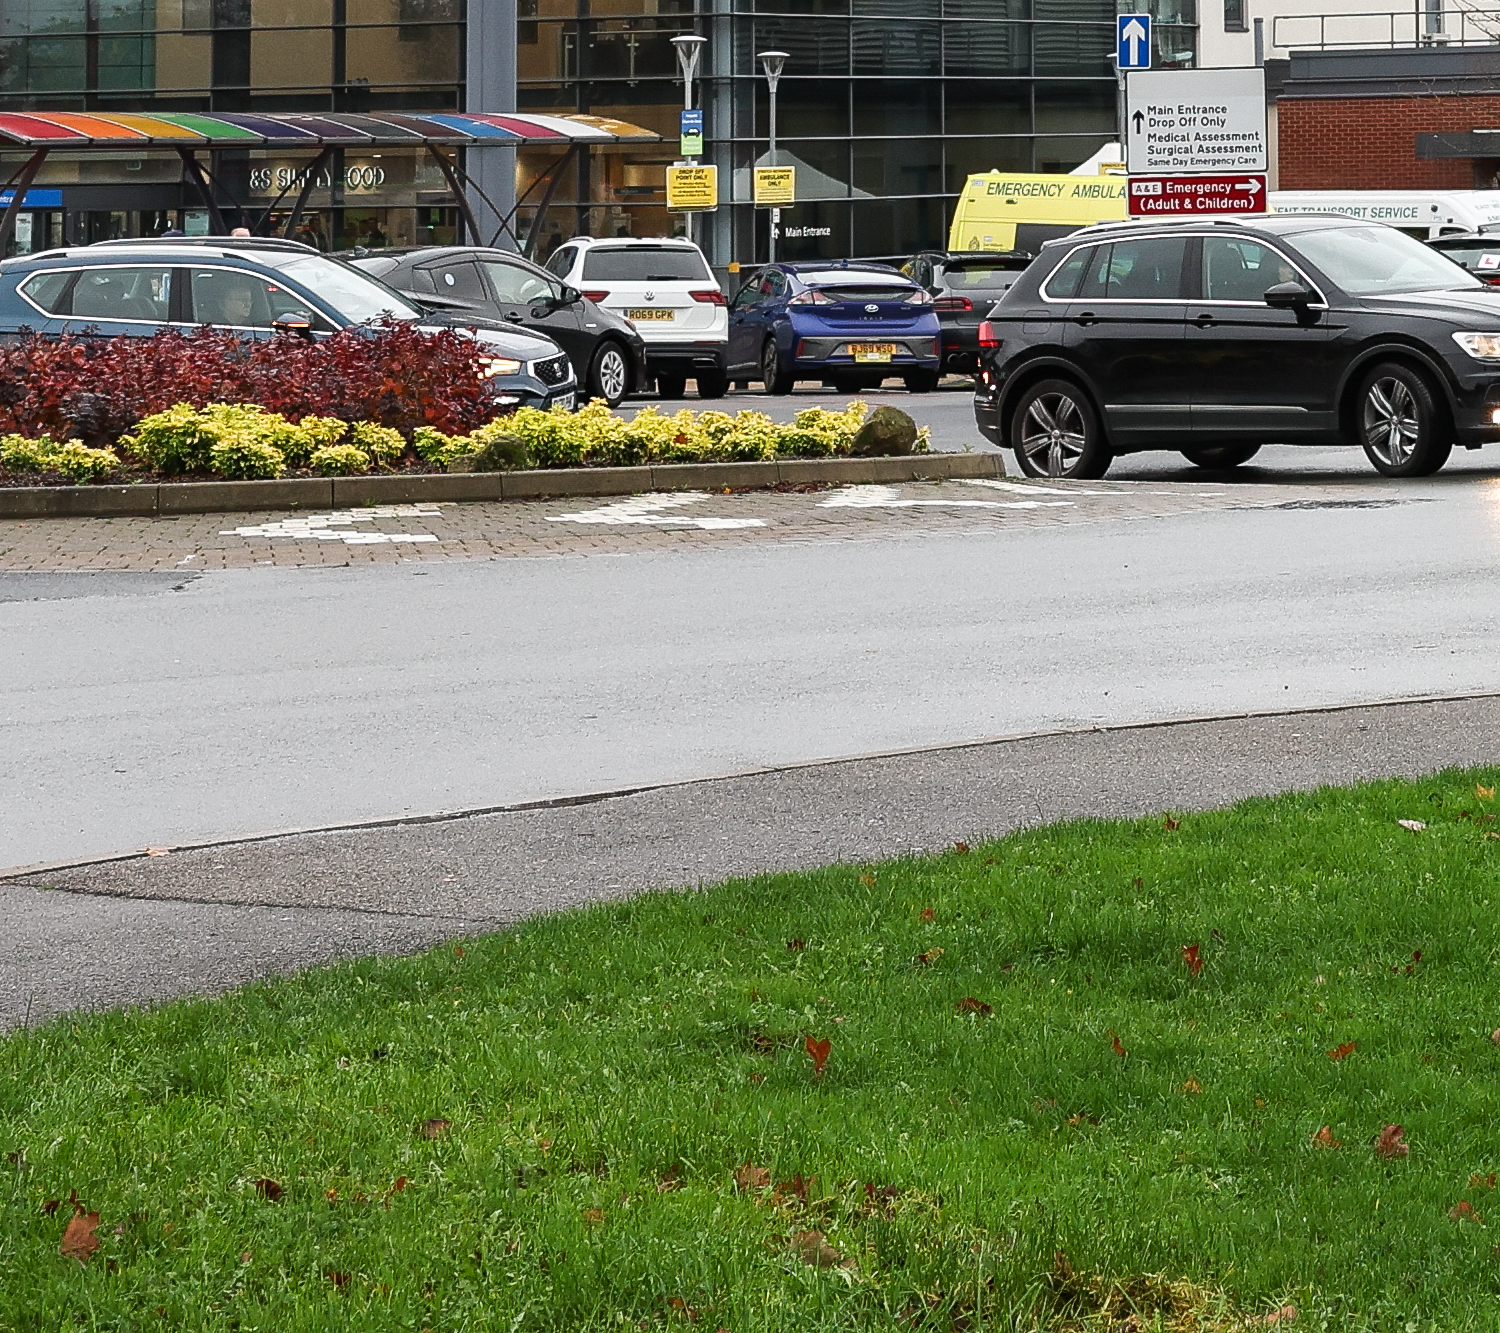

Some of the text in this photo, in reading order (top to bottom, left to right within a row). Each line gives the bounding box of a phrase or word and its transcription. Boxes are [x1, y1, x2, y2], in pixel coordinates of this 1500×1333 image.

[1147, 105, 1227, 115] Main Entrance
[1149, 116, 1226, 128] Drop Off Only
[1147, 131, 1260, 143] Medical Assessment
[1147, 143, 1263, 156] Surgical Assessment
[1147, 157, 1257, 167] Same Day Emergency Care
[986, 182, 1065, 197] EMERGENCY
[1072, 185, 1127, 199] AMBULA
[1166, 182, 1231, 194] Emergency
[1140, 196, 1255, 211] (Adult & Children)
[1371, 207, 1418, 219] SERVICE
[785, 226, 831, 237] Main Entrance
[655, 309, 673, 320] GPK
